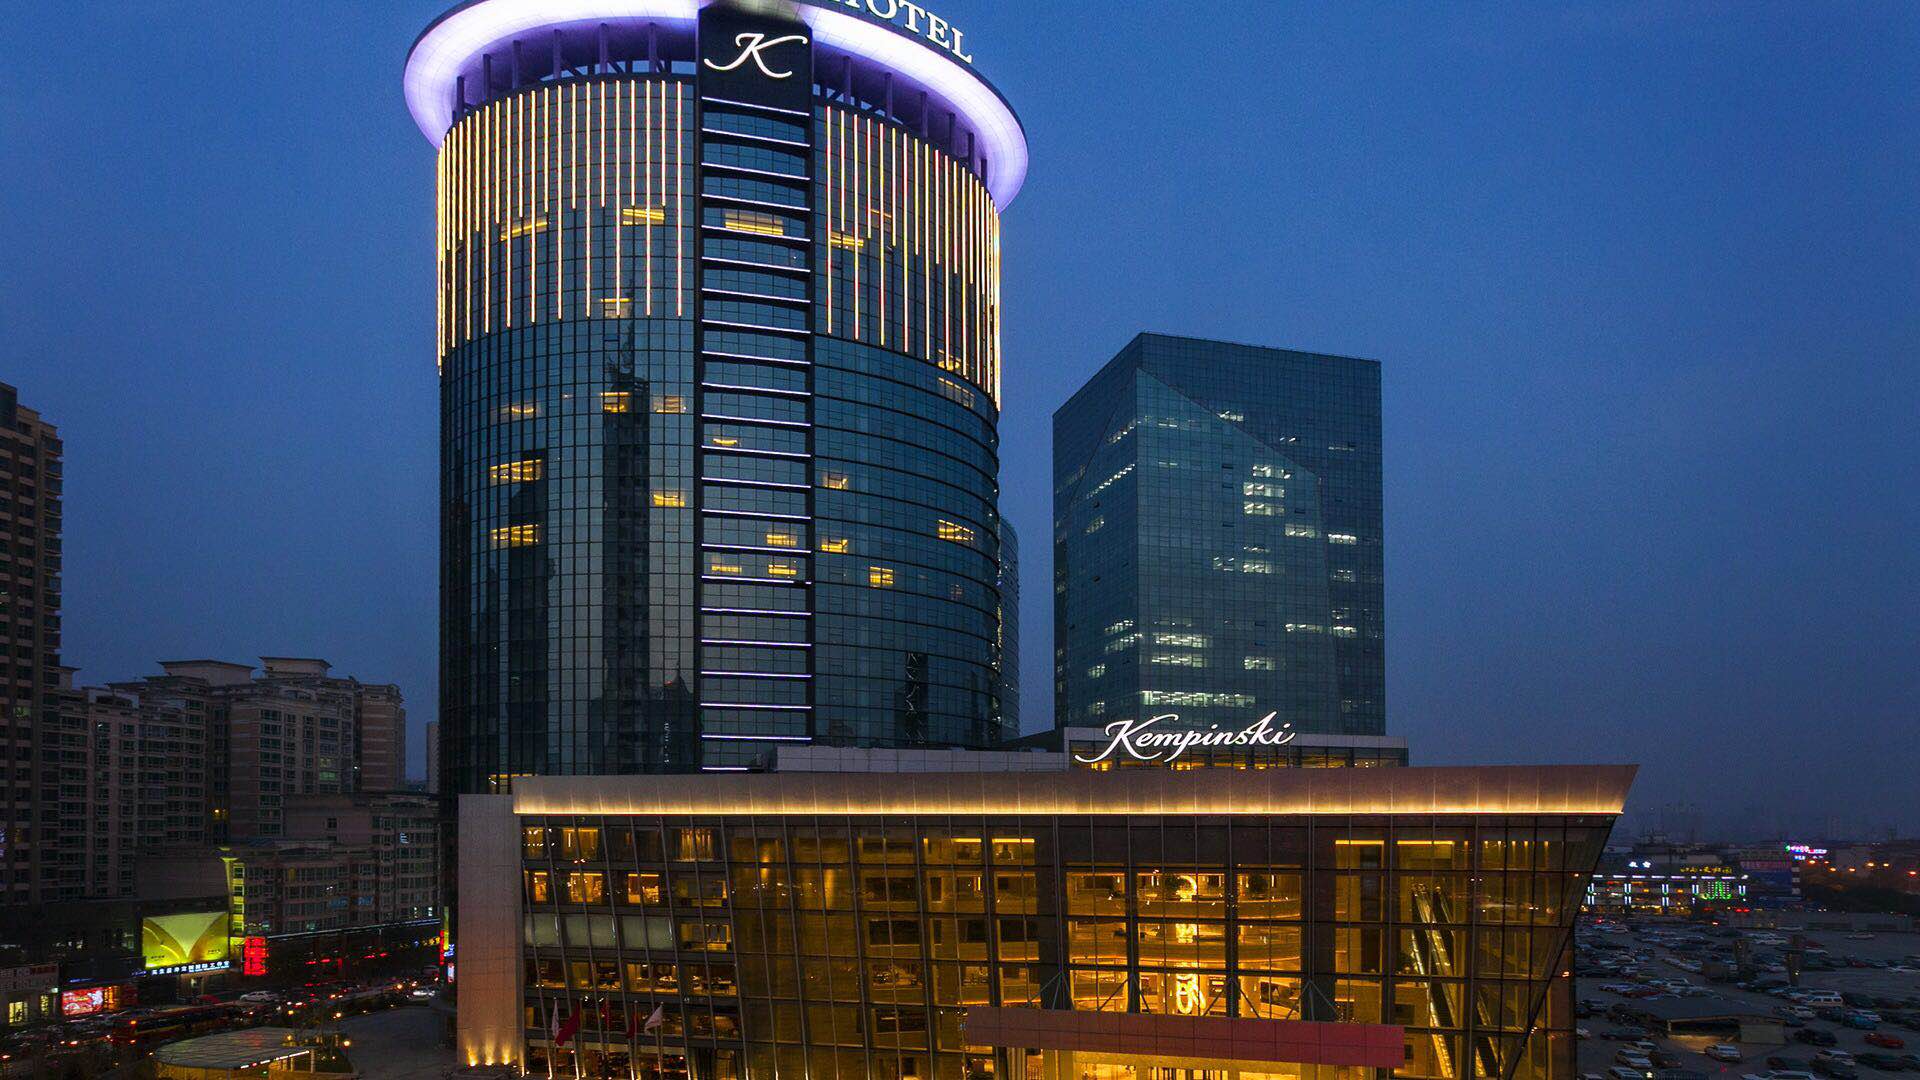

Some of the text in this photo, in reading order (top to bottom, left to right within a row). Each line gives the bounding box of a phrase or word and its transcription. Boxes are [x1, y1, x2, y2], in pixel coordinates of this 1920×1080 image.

[703, 32, 809, 79] K
[831, 0, 973, 64] OTEL
[1074, 710, 1296, 763] Kempinski
